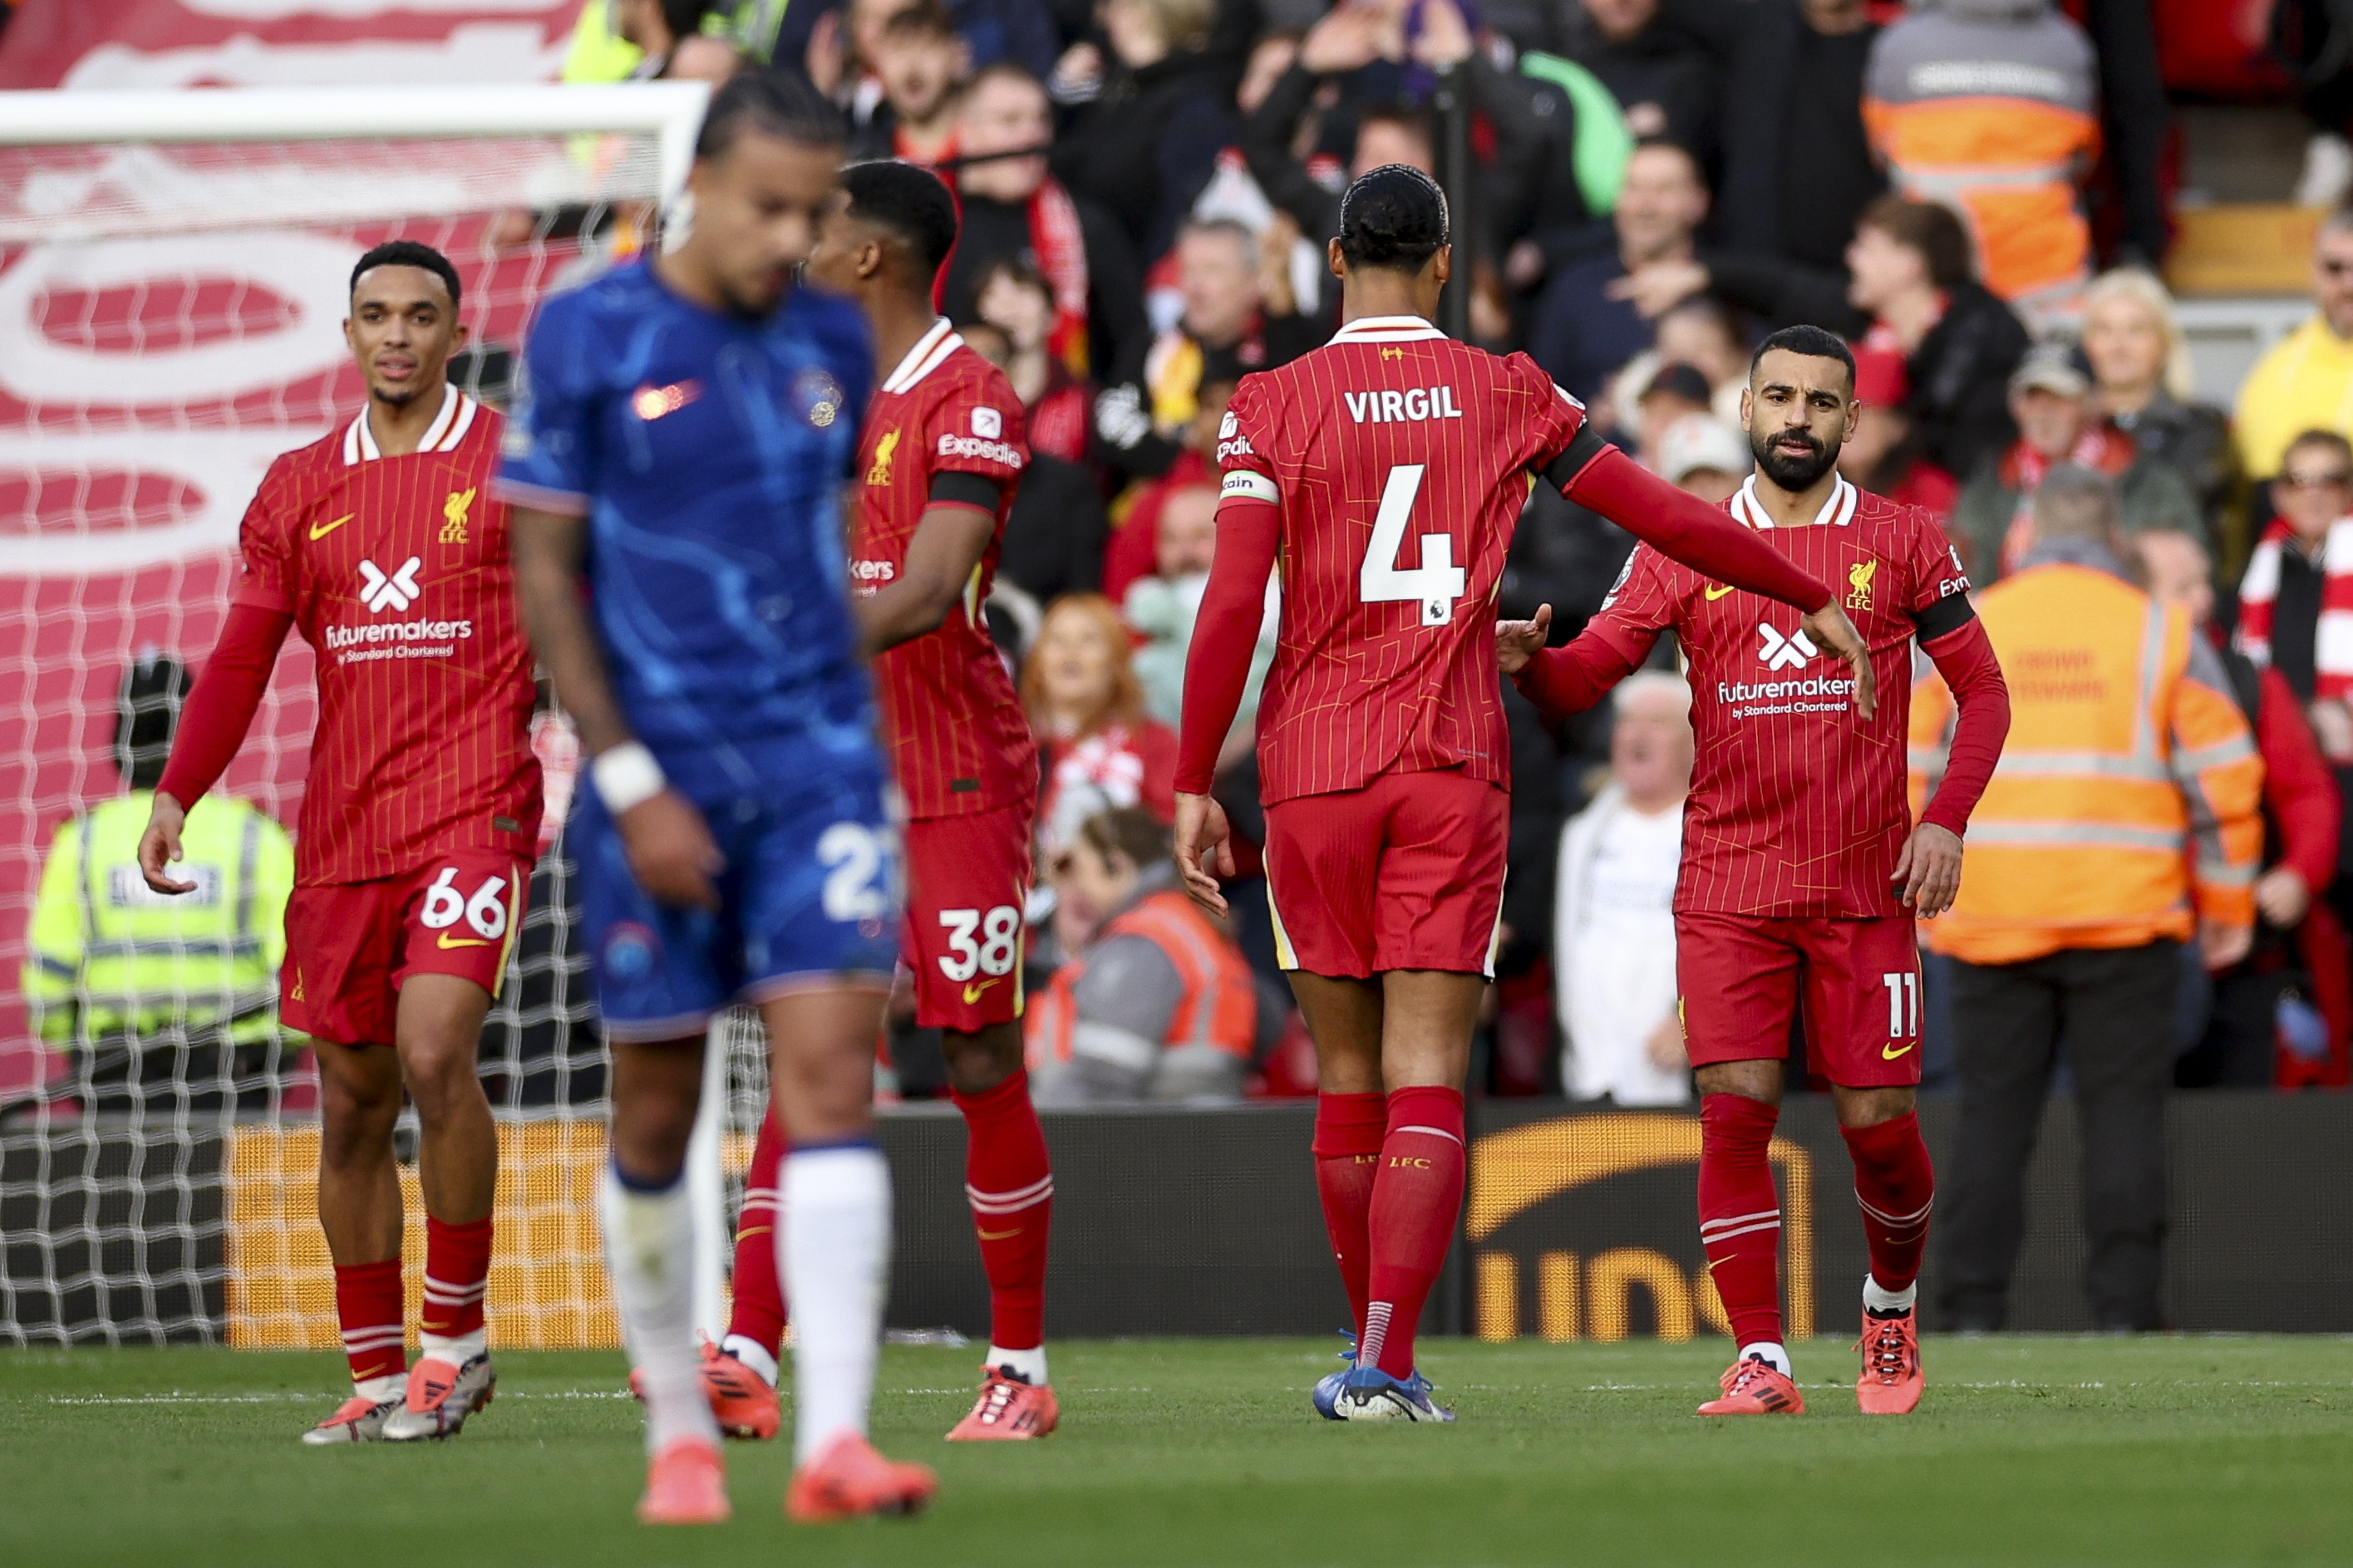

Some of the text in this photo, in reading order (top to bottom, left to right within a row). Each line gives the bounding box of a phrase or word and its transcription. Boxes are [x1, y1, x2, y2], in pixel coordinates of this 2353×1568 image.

[1343, 386, 1463, 424] VIRGIL
[938, 433, 1023, 469] Expedia
[1360, 464, 1465, 627] 4
[325, 617, 472, 650] futuremakers
[345, 646, 394, 664] Standard
[395, 643, 454, 659] Chartered
[1732, 700, 1848, 720] by Standard Chartered
[816, 821, 901, 921] 2
[420, 866, 507, 940] 66
[938, 905, 1020, 982] 38
[1883, 972, 1917, 1038] 11
[1389, 1156, 1431, 1170] LFC
